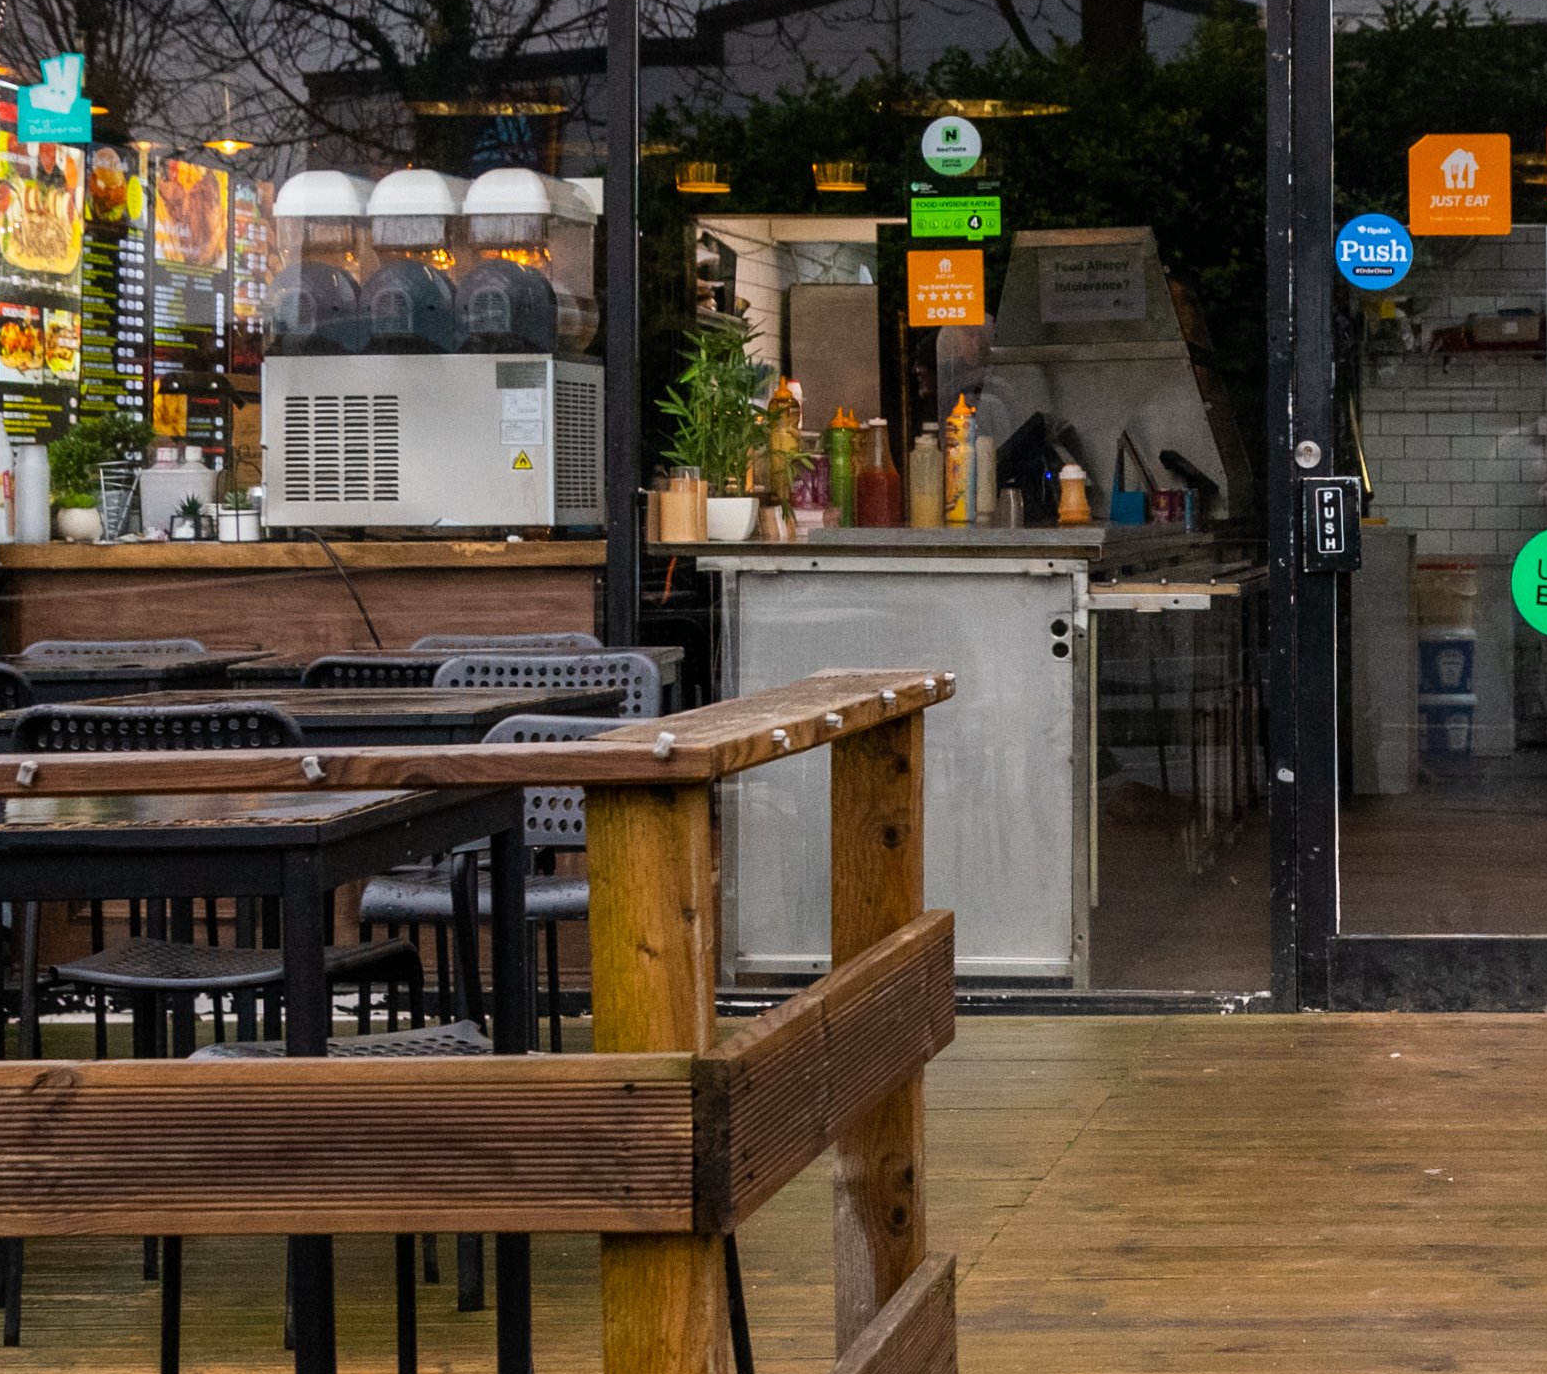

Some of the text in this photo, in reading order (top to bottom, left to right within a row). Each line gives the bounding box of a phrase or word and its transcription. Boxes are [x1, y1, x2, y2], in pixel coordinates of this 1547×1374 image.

[916, 201, 938, 209] FOOD
[1430, 195, 1492, 209] JUST EAT
[970, 216, 979, 228] 4
[1340, 239, 1407, 262] Push
[927, 307, 966, 319] 2025
[1323, 491, 1336, 550] PUSH
